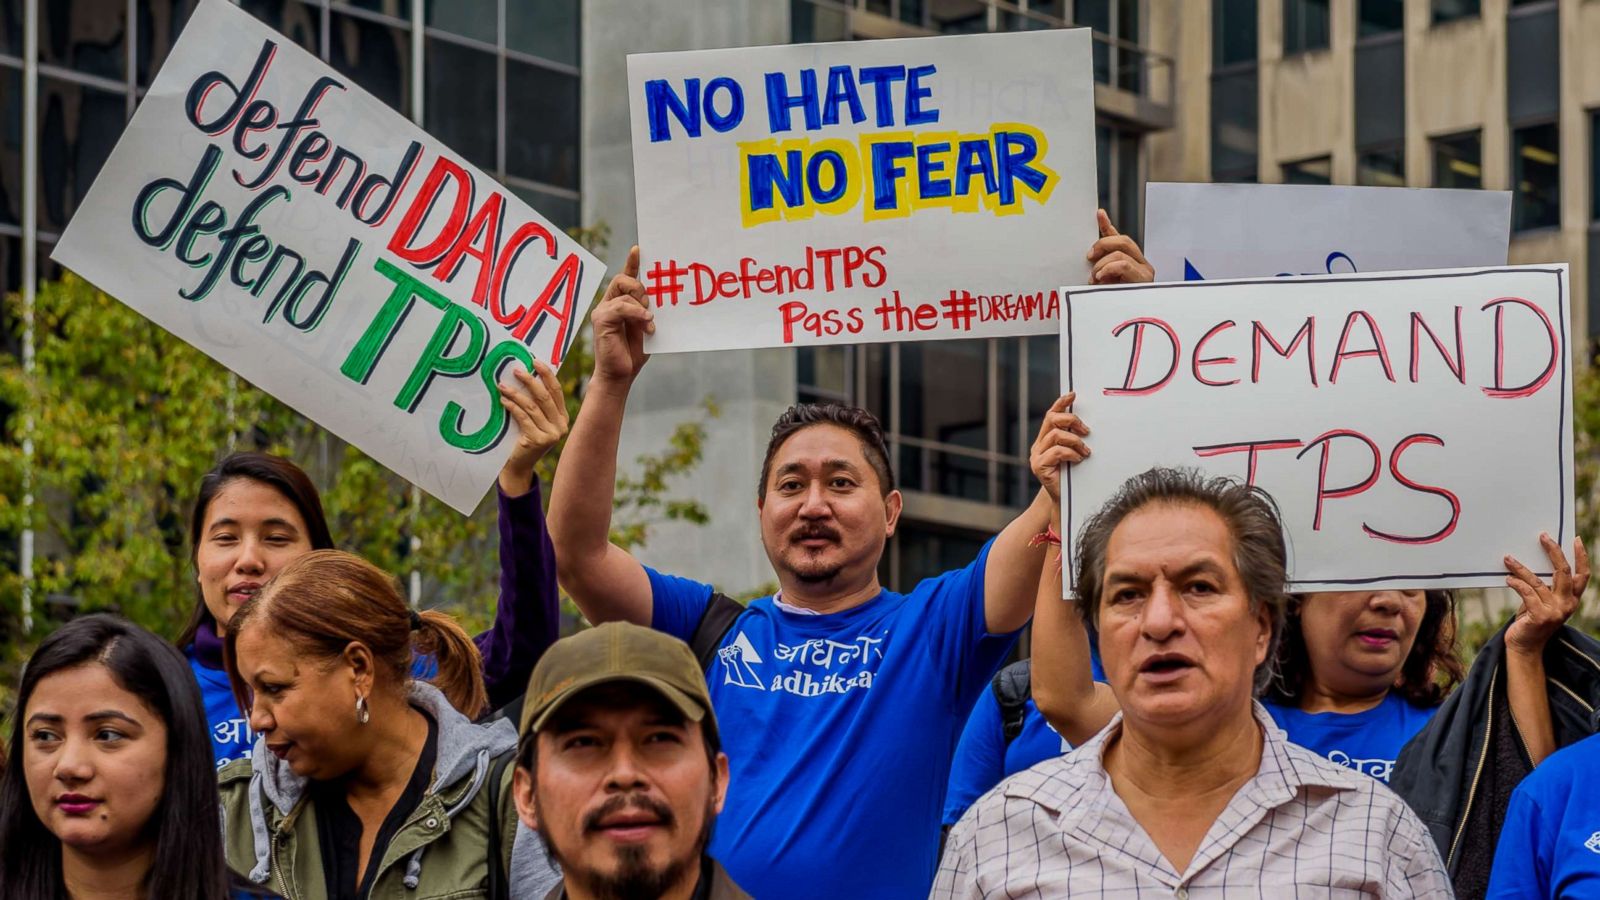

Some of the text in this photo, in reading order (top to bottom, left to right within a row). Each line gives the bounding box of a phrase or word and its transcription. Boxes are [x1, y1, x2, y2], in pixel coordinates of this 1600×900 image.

[644, 64, 940, 143] NO HATE
[185, 39, 584, 367] defend DACA
[747, 131, 1048, 212] NO FEAR
[132, 143, 535, 455] defend TPS
[646, 246, 888, 307] #DefendTPS
[778, 301, 864, 344] Pass
[874, 290, 938, 334] the
[1103, 297, 1559, 398] DEMAND
[771, 669, 878, 697] adhikaa
